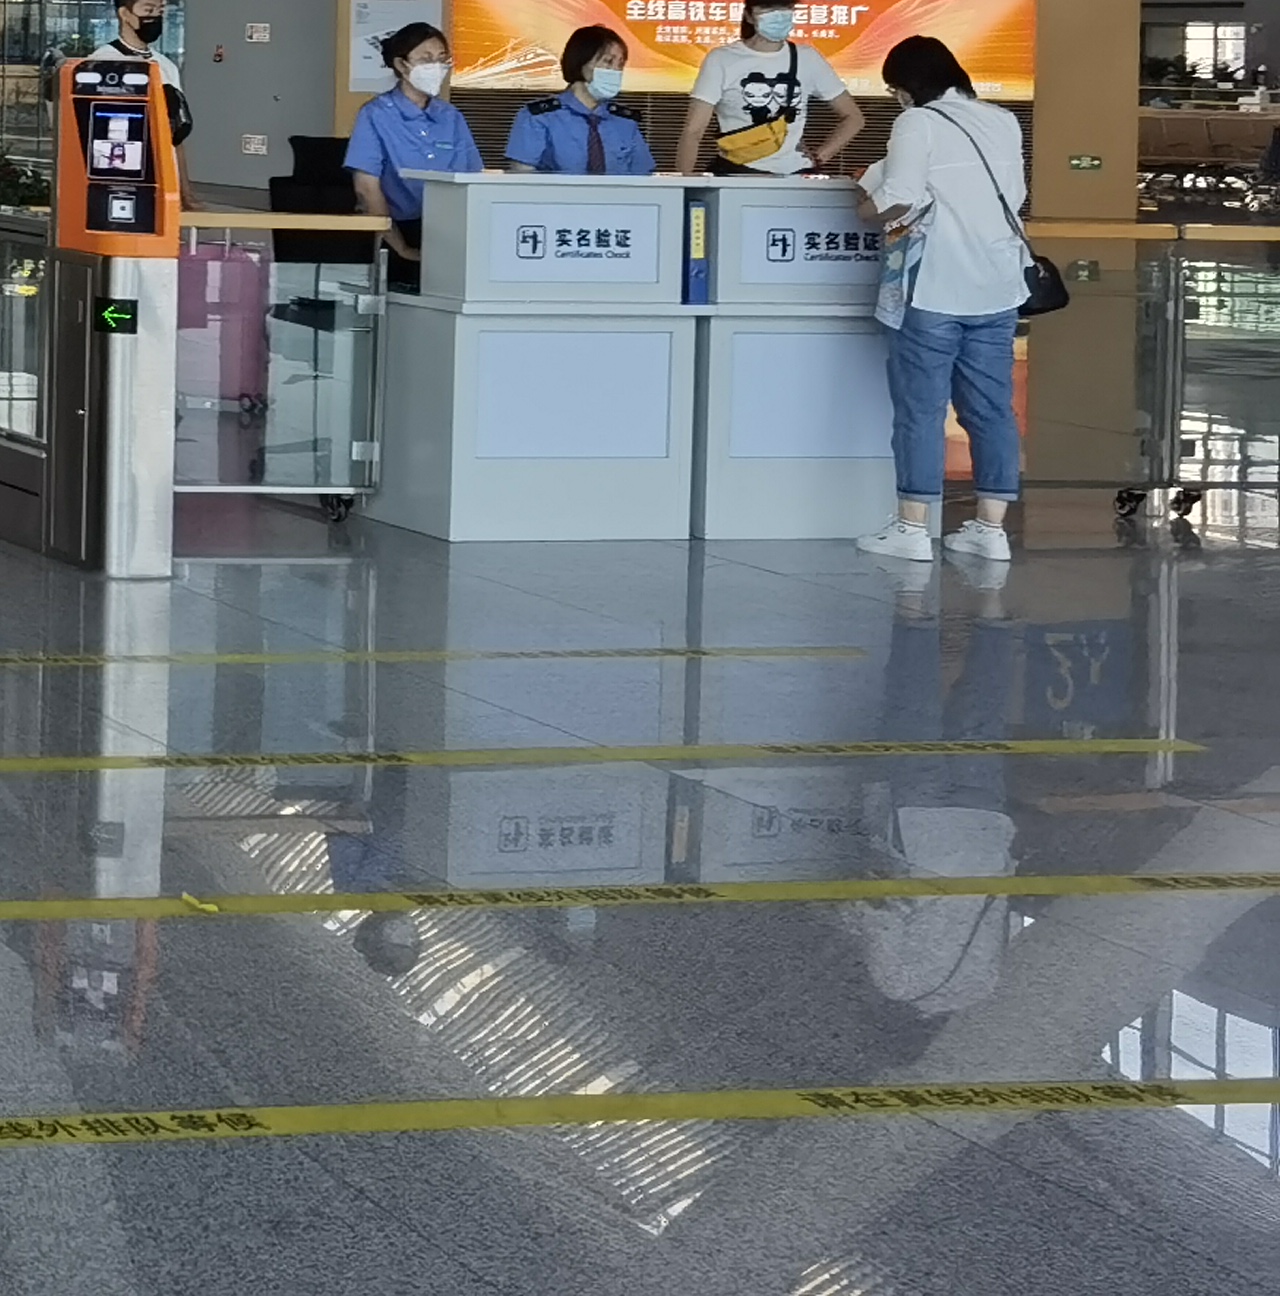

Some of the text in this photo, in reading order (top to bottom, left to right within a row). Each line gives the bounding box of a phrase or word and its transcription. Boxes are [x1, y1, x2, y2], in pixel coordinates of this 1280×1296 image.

[555, 227, 632, 249] 实名验证
[803, 231, 881, 252] 实名验证
